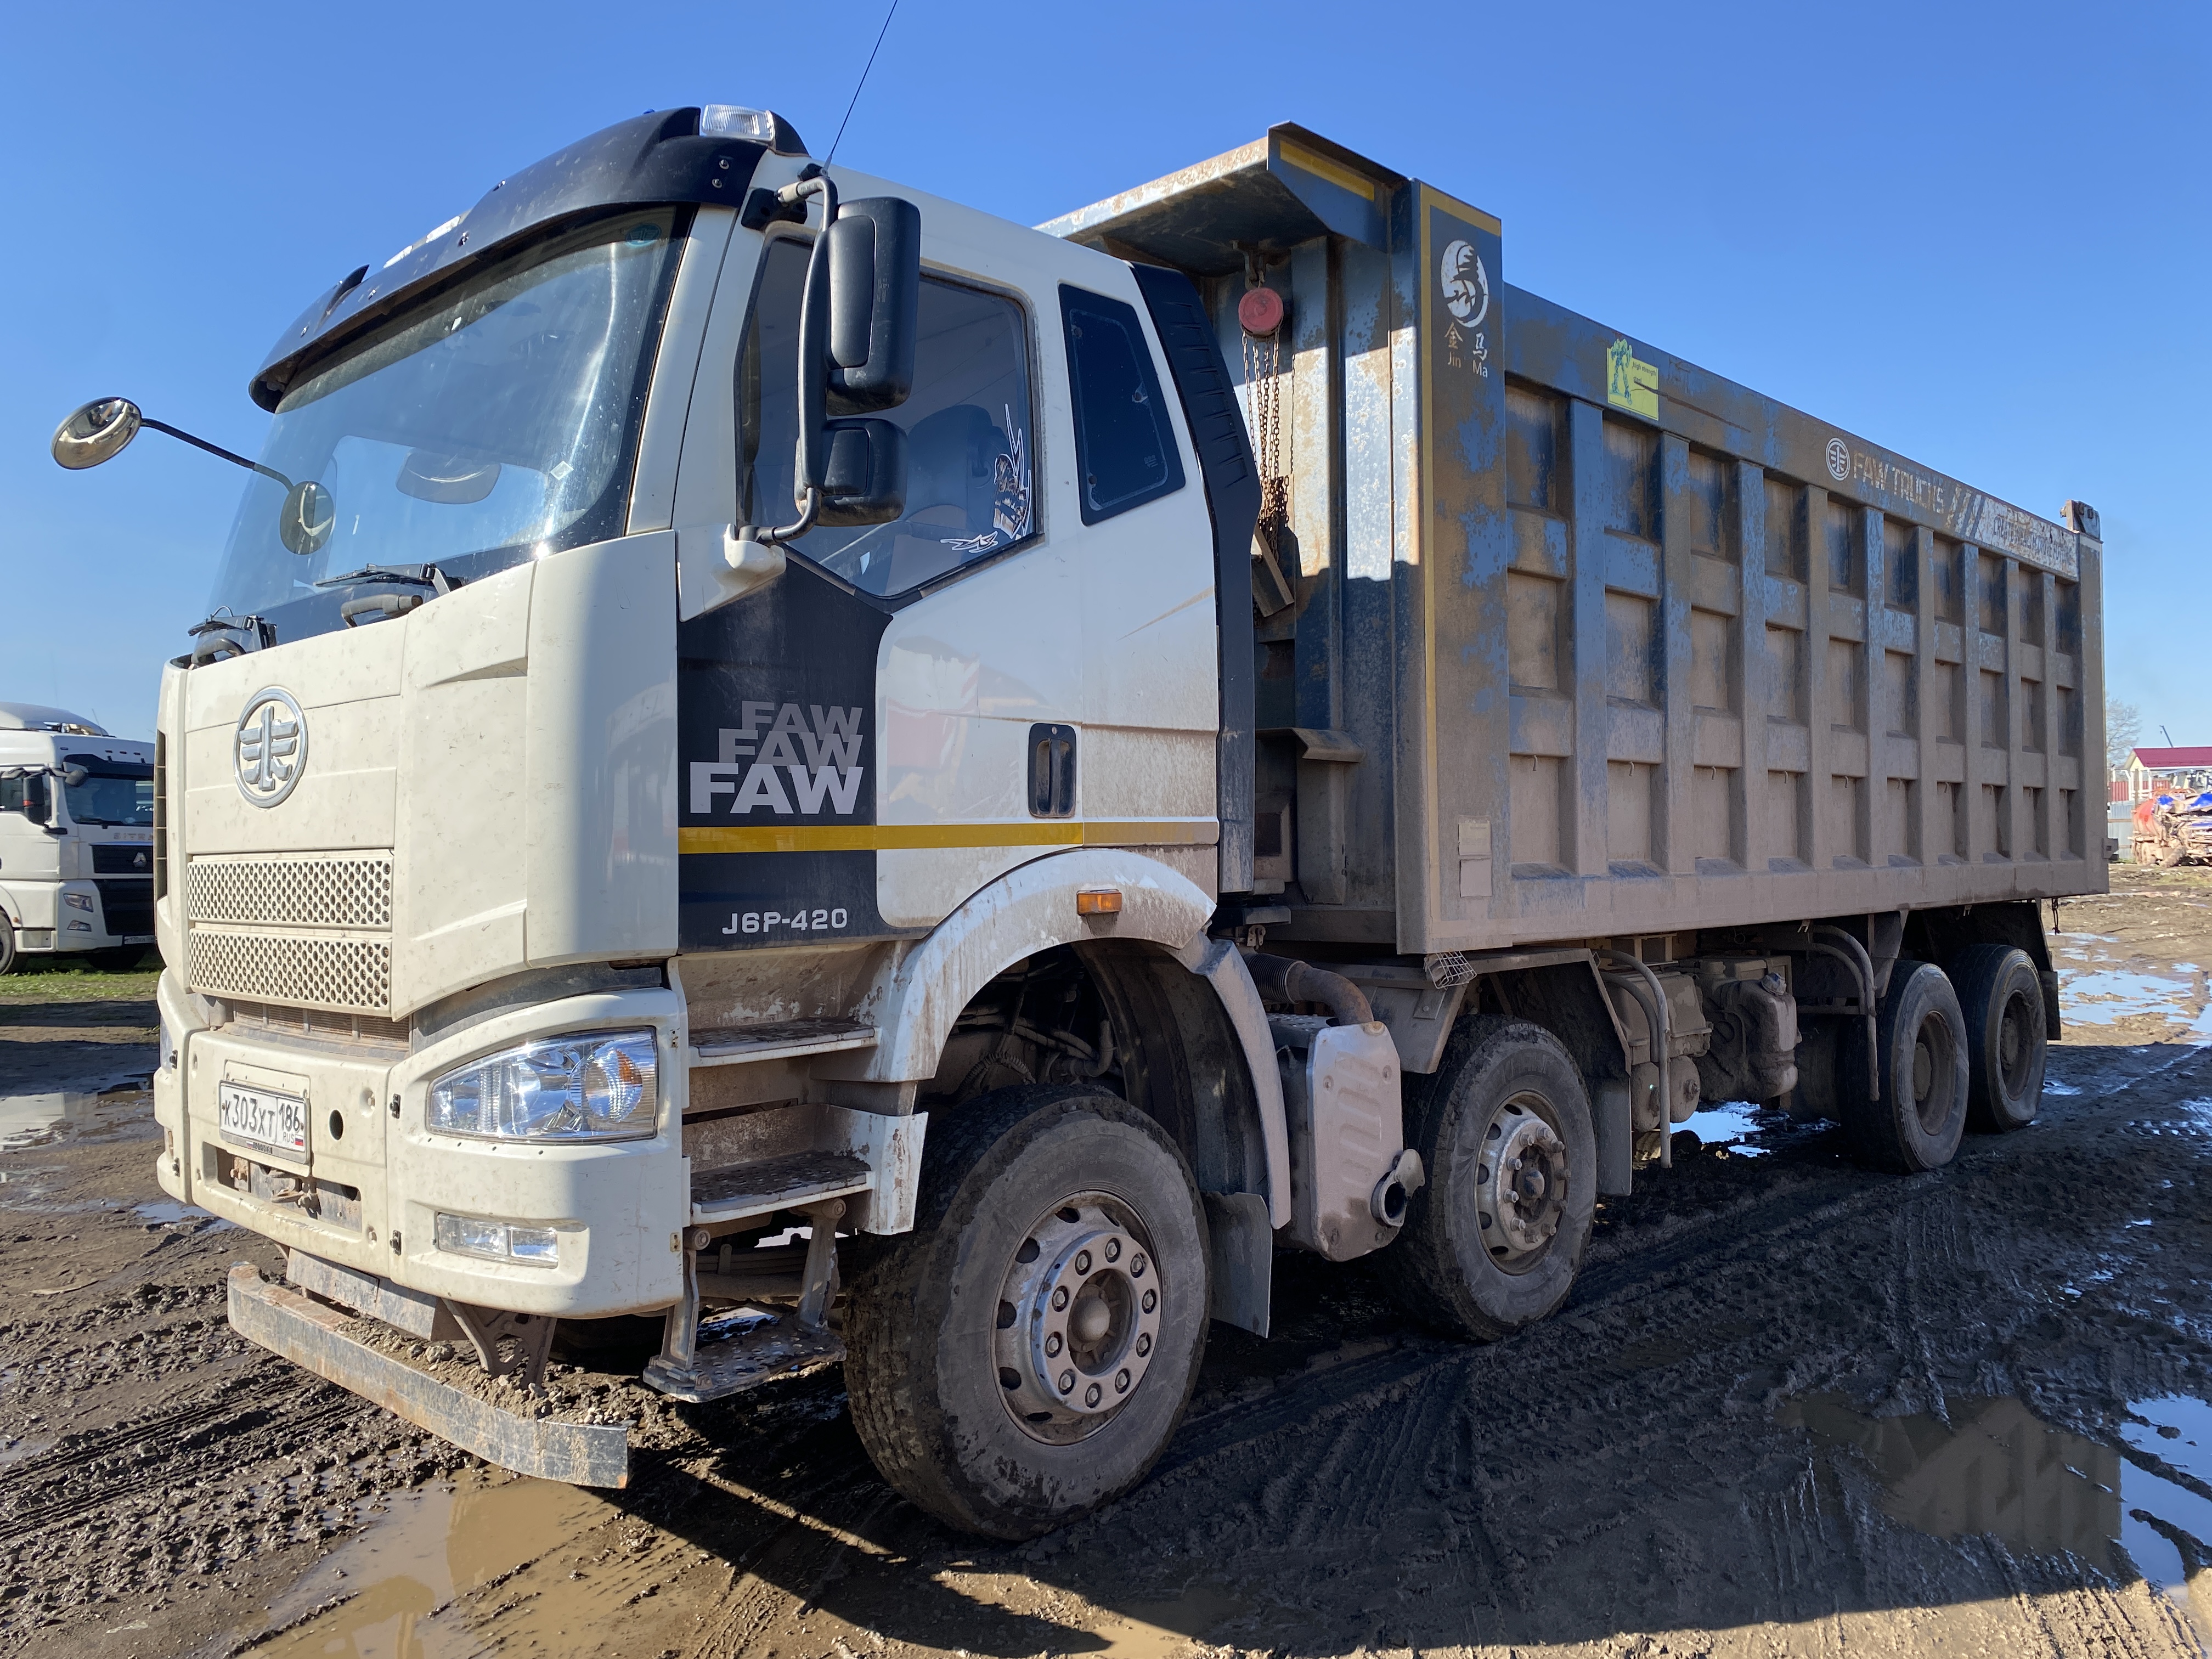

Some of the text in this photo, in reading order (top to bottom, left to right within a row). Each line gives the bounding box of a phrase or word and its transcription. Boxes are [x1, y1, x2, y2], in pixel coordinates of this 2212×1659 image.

[1448, 351, 1488, 378] Jin Ma
[1642, 366, 1657, 376] strength
[1853, 450, 1889, 490] FAW
[741, 701, 863, 742] FAW
[718, 728, 863, 775] FAW
[690, 761, 864, 815] FAW
[722, 908, 848, 935] J6P-420
[279, 1103, 300, 1133] 186
[283, 1131, 295, 1144] RUS
